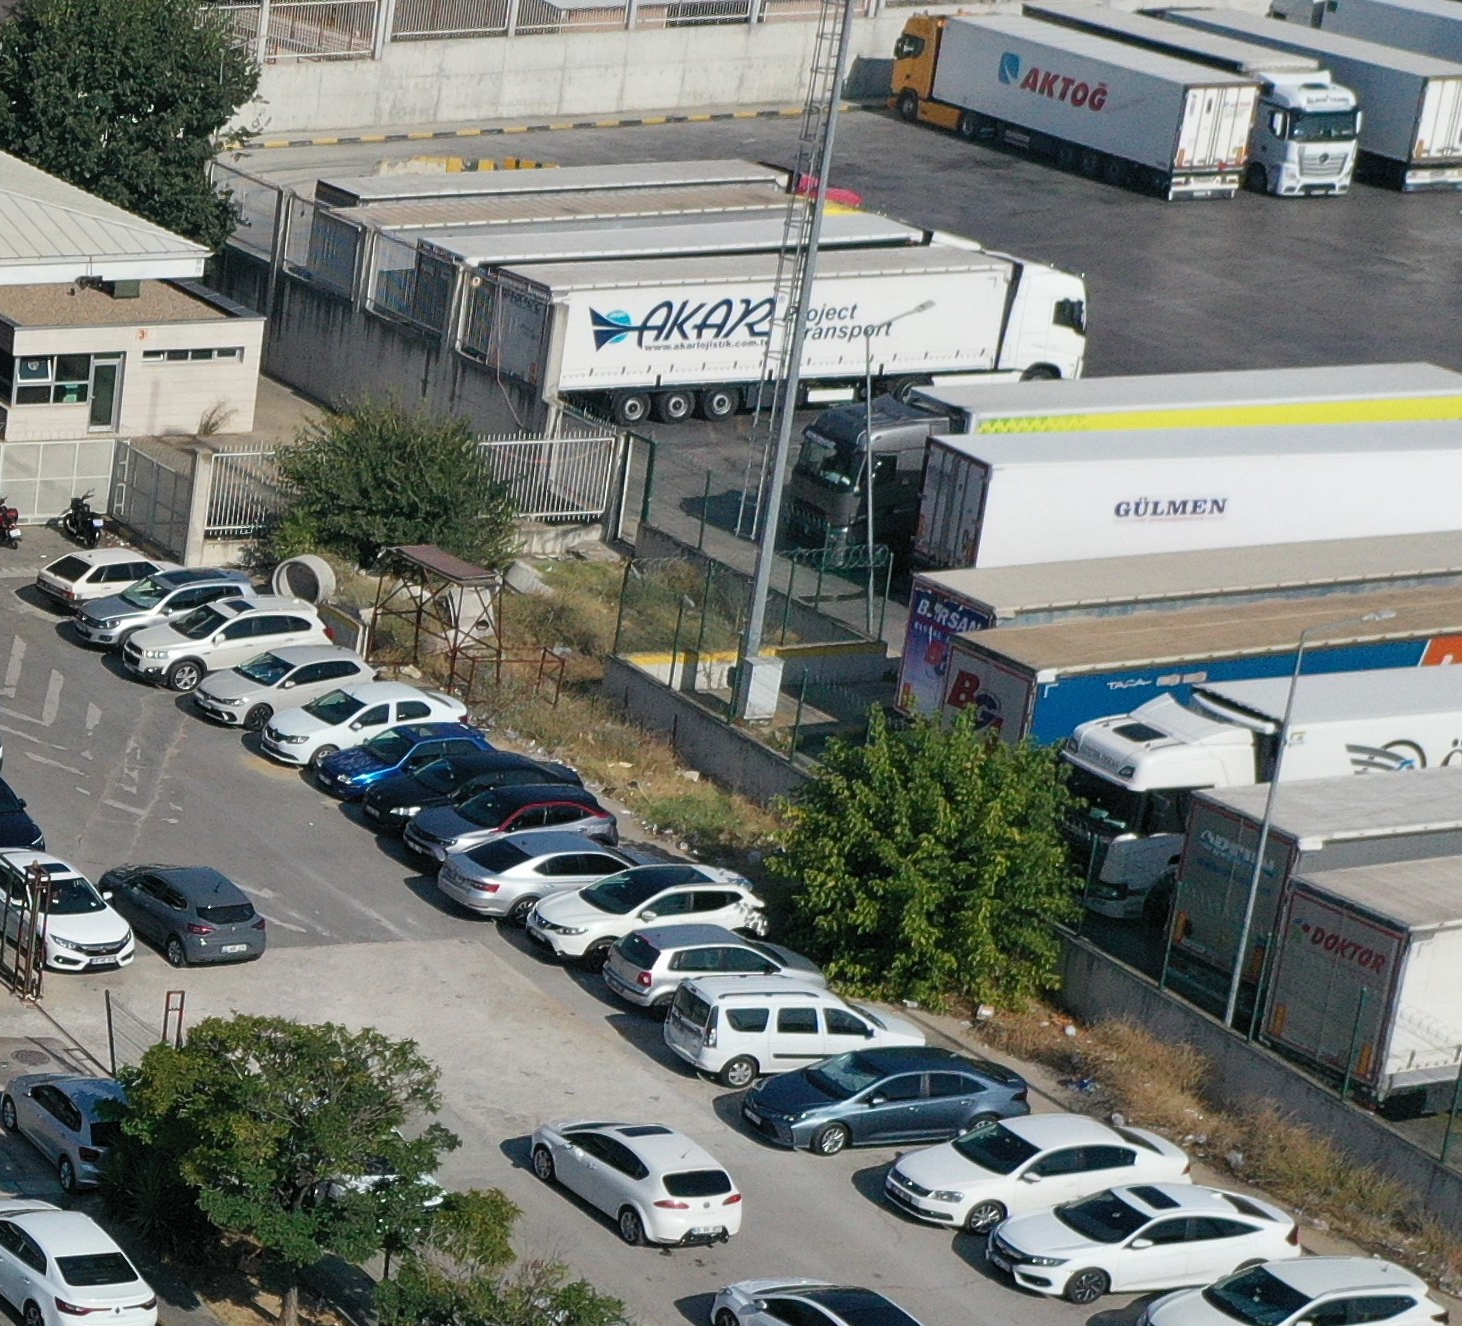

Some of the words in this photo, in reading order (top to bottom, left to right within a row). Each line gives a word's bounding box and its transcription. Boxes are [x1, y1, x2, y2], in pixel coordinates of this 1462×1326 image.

[1019, 67, 1108, 111] AKTOĞ
[636, 297, 776, 349] AKAR
[790, 303, 857, 326] oject
[801, 320, 893, 341] ransport
[1114, 496, 1227, 518] GÜLMEN
